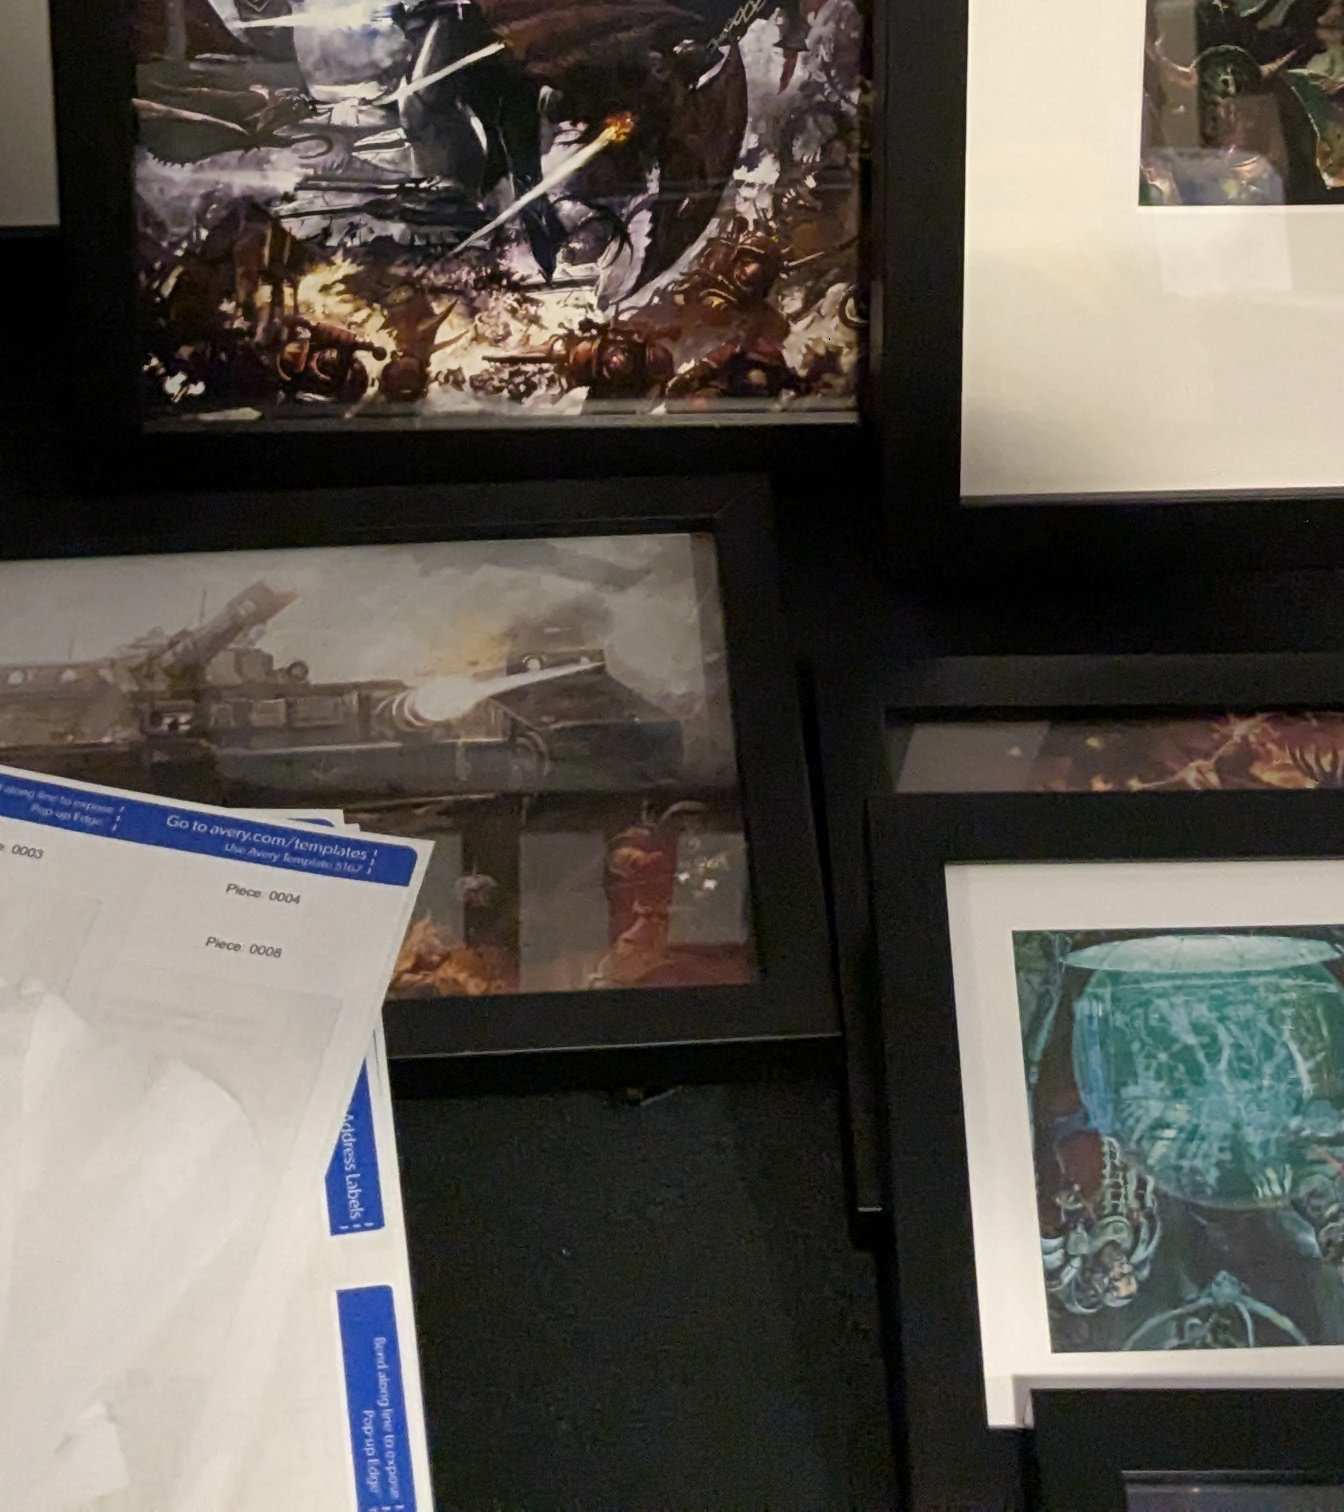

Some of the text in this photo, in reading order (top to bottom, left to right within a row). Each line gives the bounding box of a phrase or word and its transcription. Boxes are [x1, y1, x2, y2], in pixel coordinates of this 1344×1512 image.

[11, 843, 45, 860] 0003
[166, 814, 368, 861] Go to avery.com/templates
[247, 847, 281, 864] Avery
[268, 889, 302, 905] 0004
[345, 1173, 365, 1220] Labels
[373, 1336, 389, 1370] Bend
[376, 1371, 391, 1407] along
[384, 1435, 395, 1449] to
[385, 1450, 400, 1500] expose
